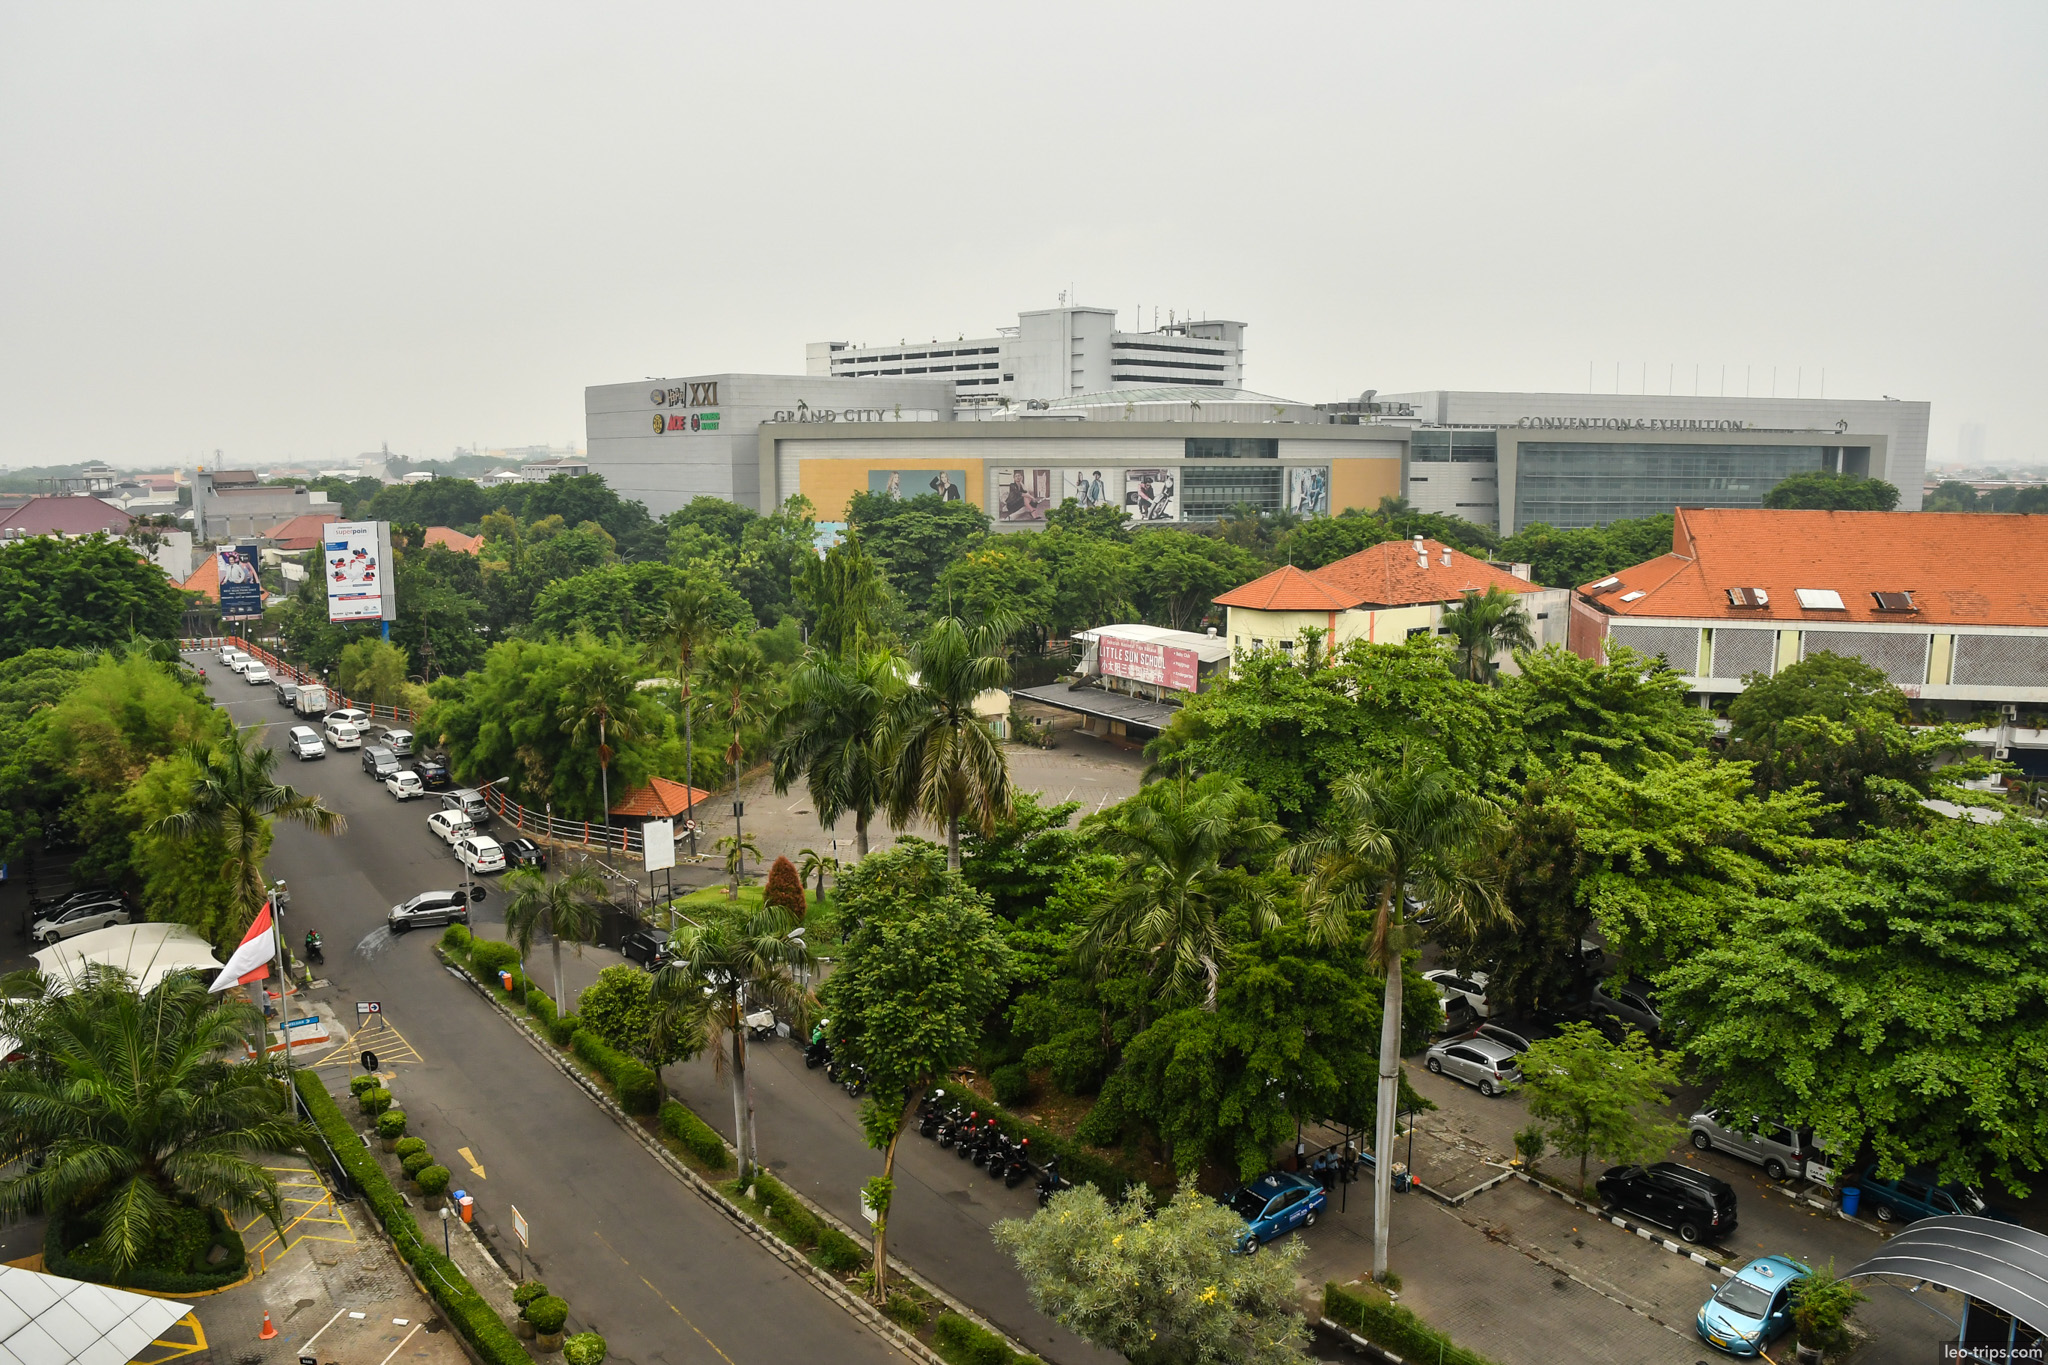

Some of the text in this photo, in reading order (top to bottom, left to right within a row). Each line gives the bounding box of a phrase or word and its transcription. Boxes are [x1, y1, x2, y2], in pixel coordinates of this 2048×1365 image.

[689, 382, 719, 407] XXI
[667, 414, 686, 431] ACE
[773, 408, 886, 424] GRAND CITY
[1517, 416, 1744, 432] CONVENTION & EXHIBITION
[1099, 645, 1165, 669] LITTLE SUN SCHOOL
